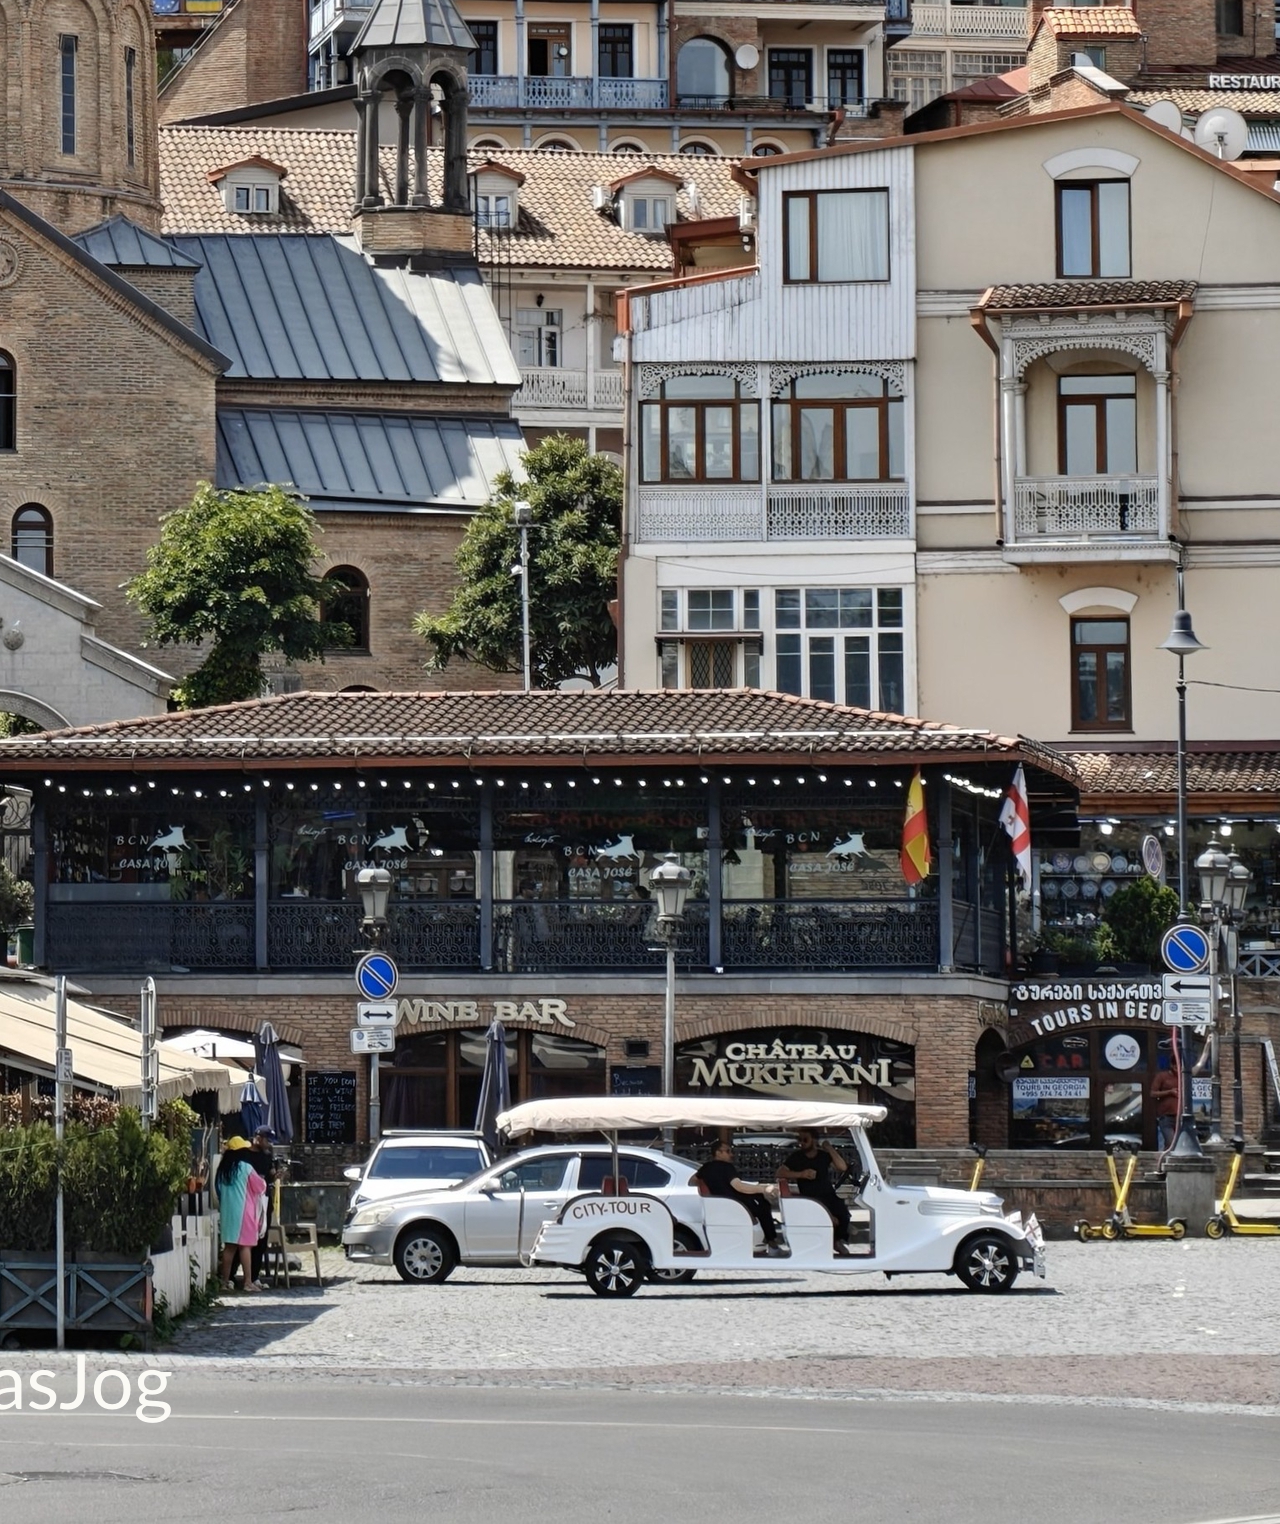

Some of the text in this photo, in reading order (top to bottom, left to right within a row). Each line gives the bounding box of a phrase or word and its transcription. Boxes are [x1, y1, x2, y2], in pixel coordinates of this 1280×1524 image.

[1209, 74, 1280, 89] RESTAUR
[119, 858, 151, 869] CASA
[344, 857, 409, 871] CASA JOSÉ
[789, 860, 855, 875] CASA JOSÉ
[567, 864, 633, 880] CASA JOSÉ
[395, 998, 576, 1027] WINE BAR
[1031, 1001, 1207, 1037] TOURS IN GEOA
[725, 1038, 858, 1061] CHÂTEAU
[688, 1058, 892, 1087] MUKHRANI
[324, 1076, 338, 1085] YOU
[334, 1087, 354, 1096] WINE
[308, 1121, 346, 1130] LOVE THEM
[572, 1200, 652, 1220] CITY-TOUR
